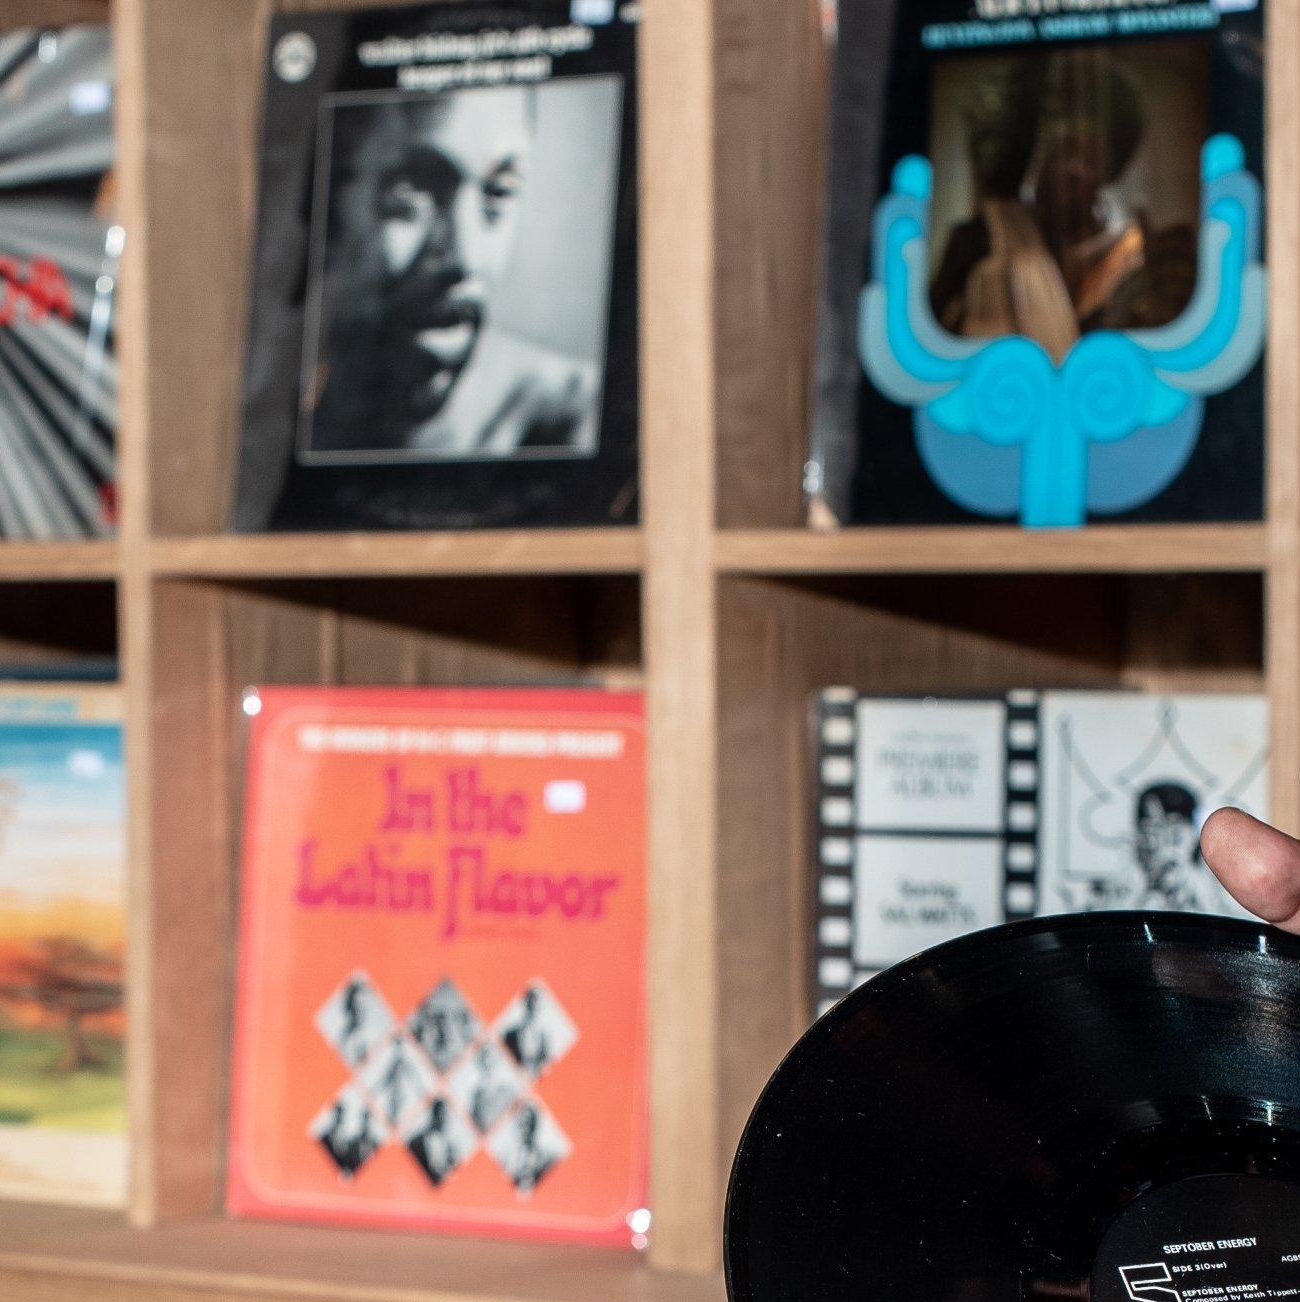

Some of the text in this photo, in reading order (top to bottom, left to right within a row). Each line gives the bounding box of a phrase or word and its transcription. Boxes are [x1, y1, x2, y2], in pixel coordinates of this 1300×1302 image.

[297, 836, 620, 940] Latin Flavor
[1163, 1237, 1257, 1254] SEPTOBER ENERGY
[1172, 1265, 1193, 1273] SIDE
[1181, 1283, 1258, 1297] SEPTOBER ENERGY
[1231, 1293, 1241, 1301] by
[1243, 1291, 1266, 1300] Keith
